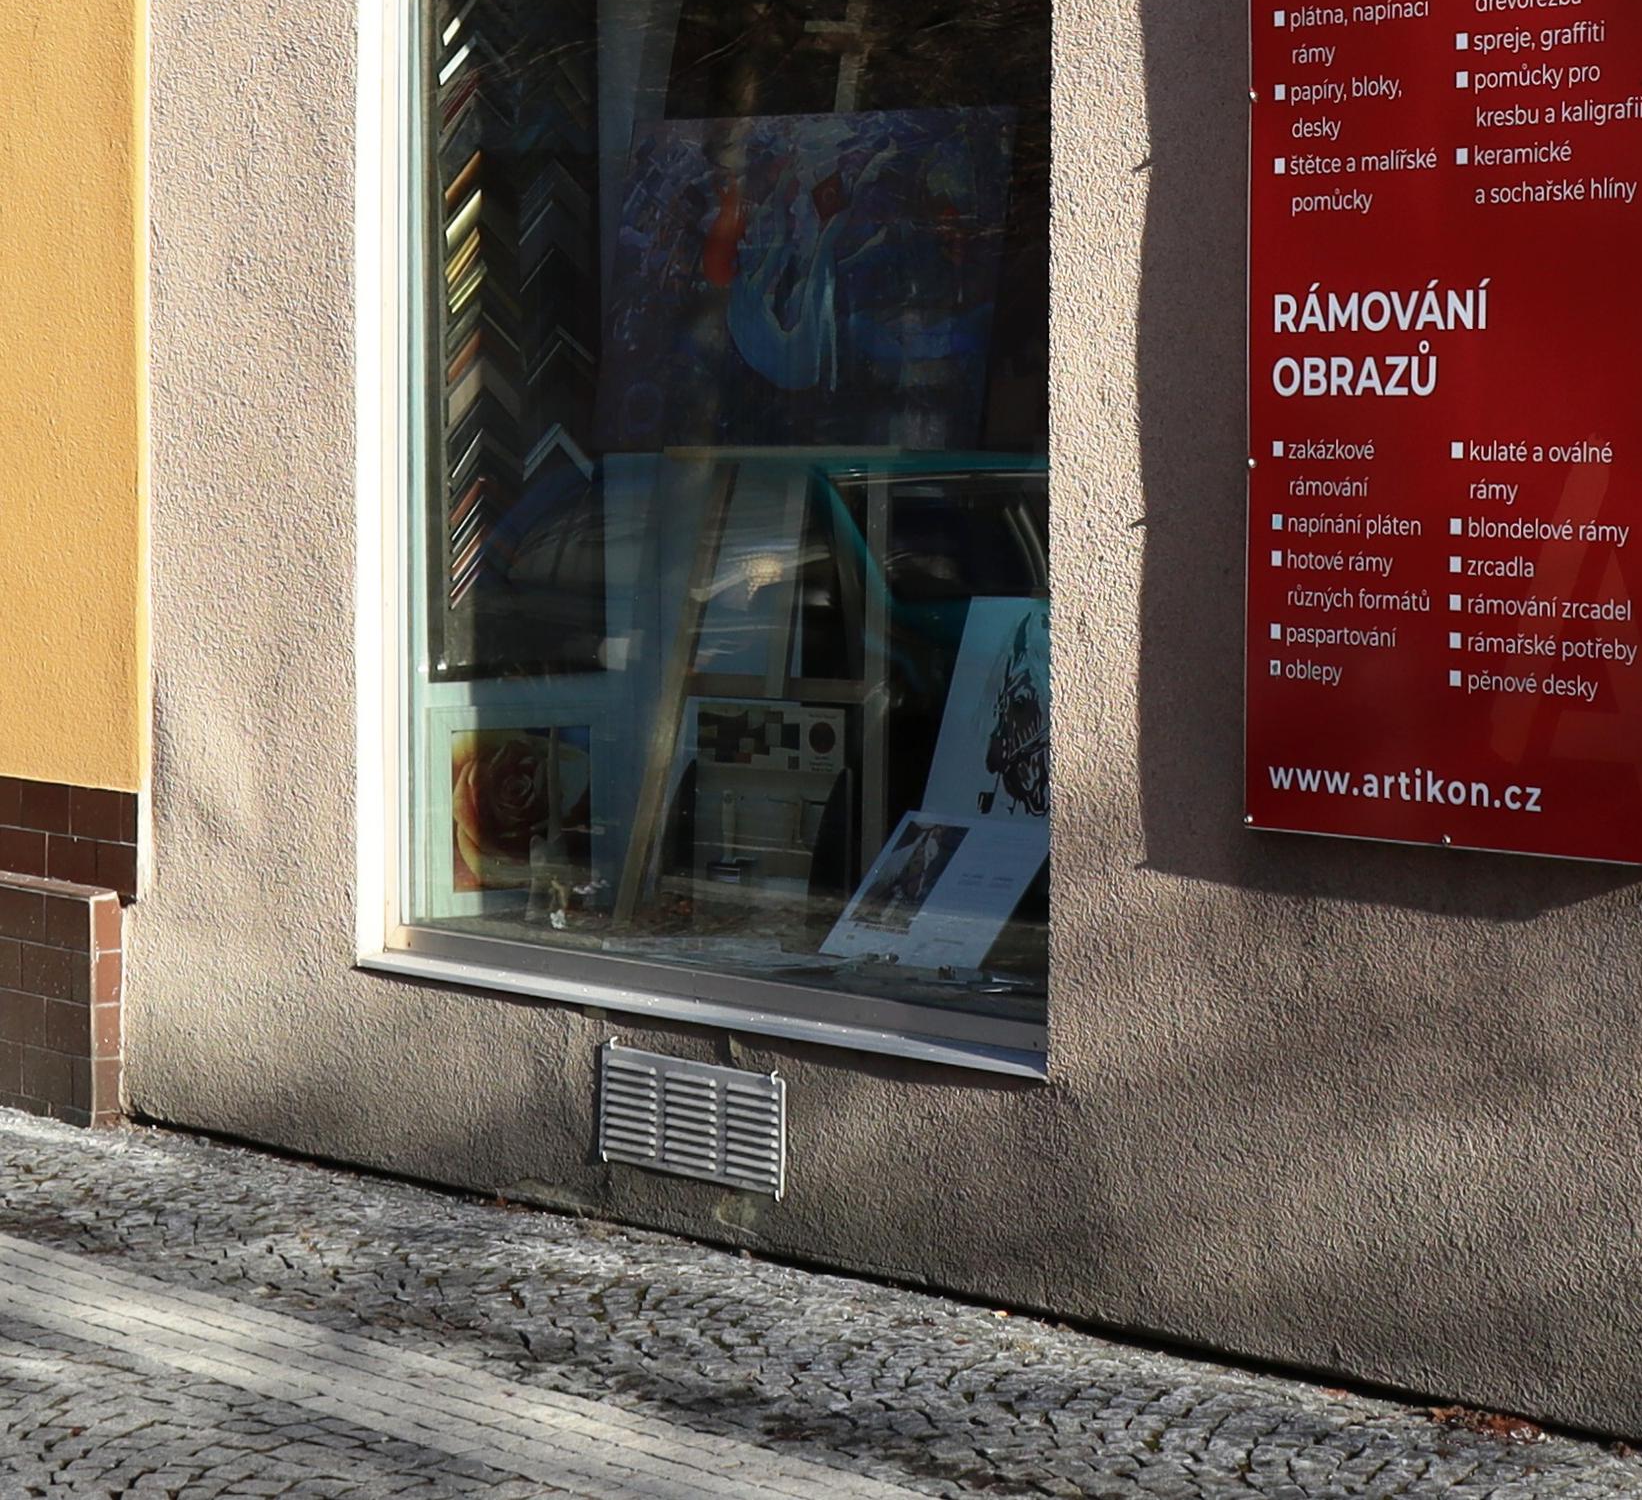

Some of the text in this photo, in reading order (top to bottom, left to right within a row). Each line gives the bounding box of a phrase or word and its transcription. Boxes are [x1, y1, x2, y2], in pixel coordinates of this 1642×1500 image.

[1290, 4, 1348, 33] plátna,
[1473, 19, 1605, 57] spreje, graffiti
[1291, 42, 1336, 68] rámy
[1290, 73, 1403, 106] papíry, bloky,
[1474, 64, 1601, 94] pomůcky pro
[1476, 101, 1539, 128] kresbu
[1544, 105, 1556, 123] a
[1291, 116, 1341, 142] desky
[1289, 149, 1437, 175] štětce a malířské
[1473, 141, 1572, 167] keramické
[1291, 187, 1373, 218] pomůcky
[1475, 176, 1637, 205] a sochařské hlíny
[1273, 278, 1492, 333] RÁMOVÁNÍ
[1272, 340, 1438, 397] OBRAZŮ
[1288, 438, 1375, 462] zakázkové
[1469, 439, 1613, 465] kulaté a oválné
[1289, 475, 1368, 497] rámování
[1469, 478, 1518, 504] rámy
[1288, 513, 1421, 538] napínání pláten
[1467, 516, 1630, 549] blondelové rámy
[1286, 548, 1393, 577] hotové rámy
[1467, 555, 1534, 579] zrcadla
[1287, 583, 1430, 613] různých formátů
[1467, 593, 1631, 621] rámování zrcadel
[1286, 624, 1396, 649] paspartování
[1467, 631, 1638, 666] rámařské potřeby
[1285, 659, 1342, 686] oblepy
[1467, 668, 1598, 702] pěnové desky
[1269, 764, 1542, 813] www.artikon.cz
